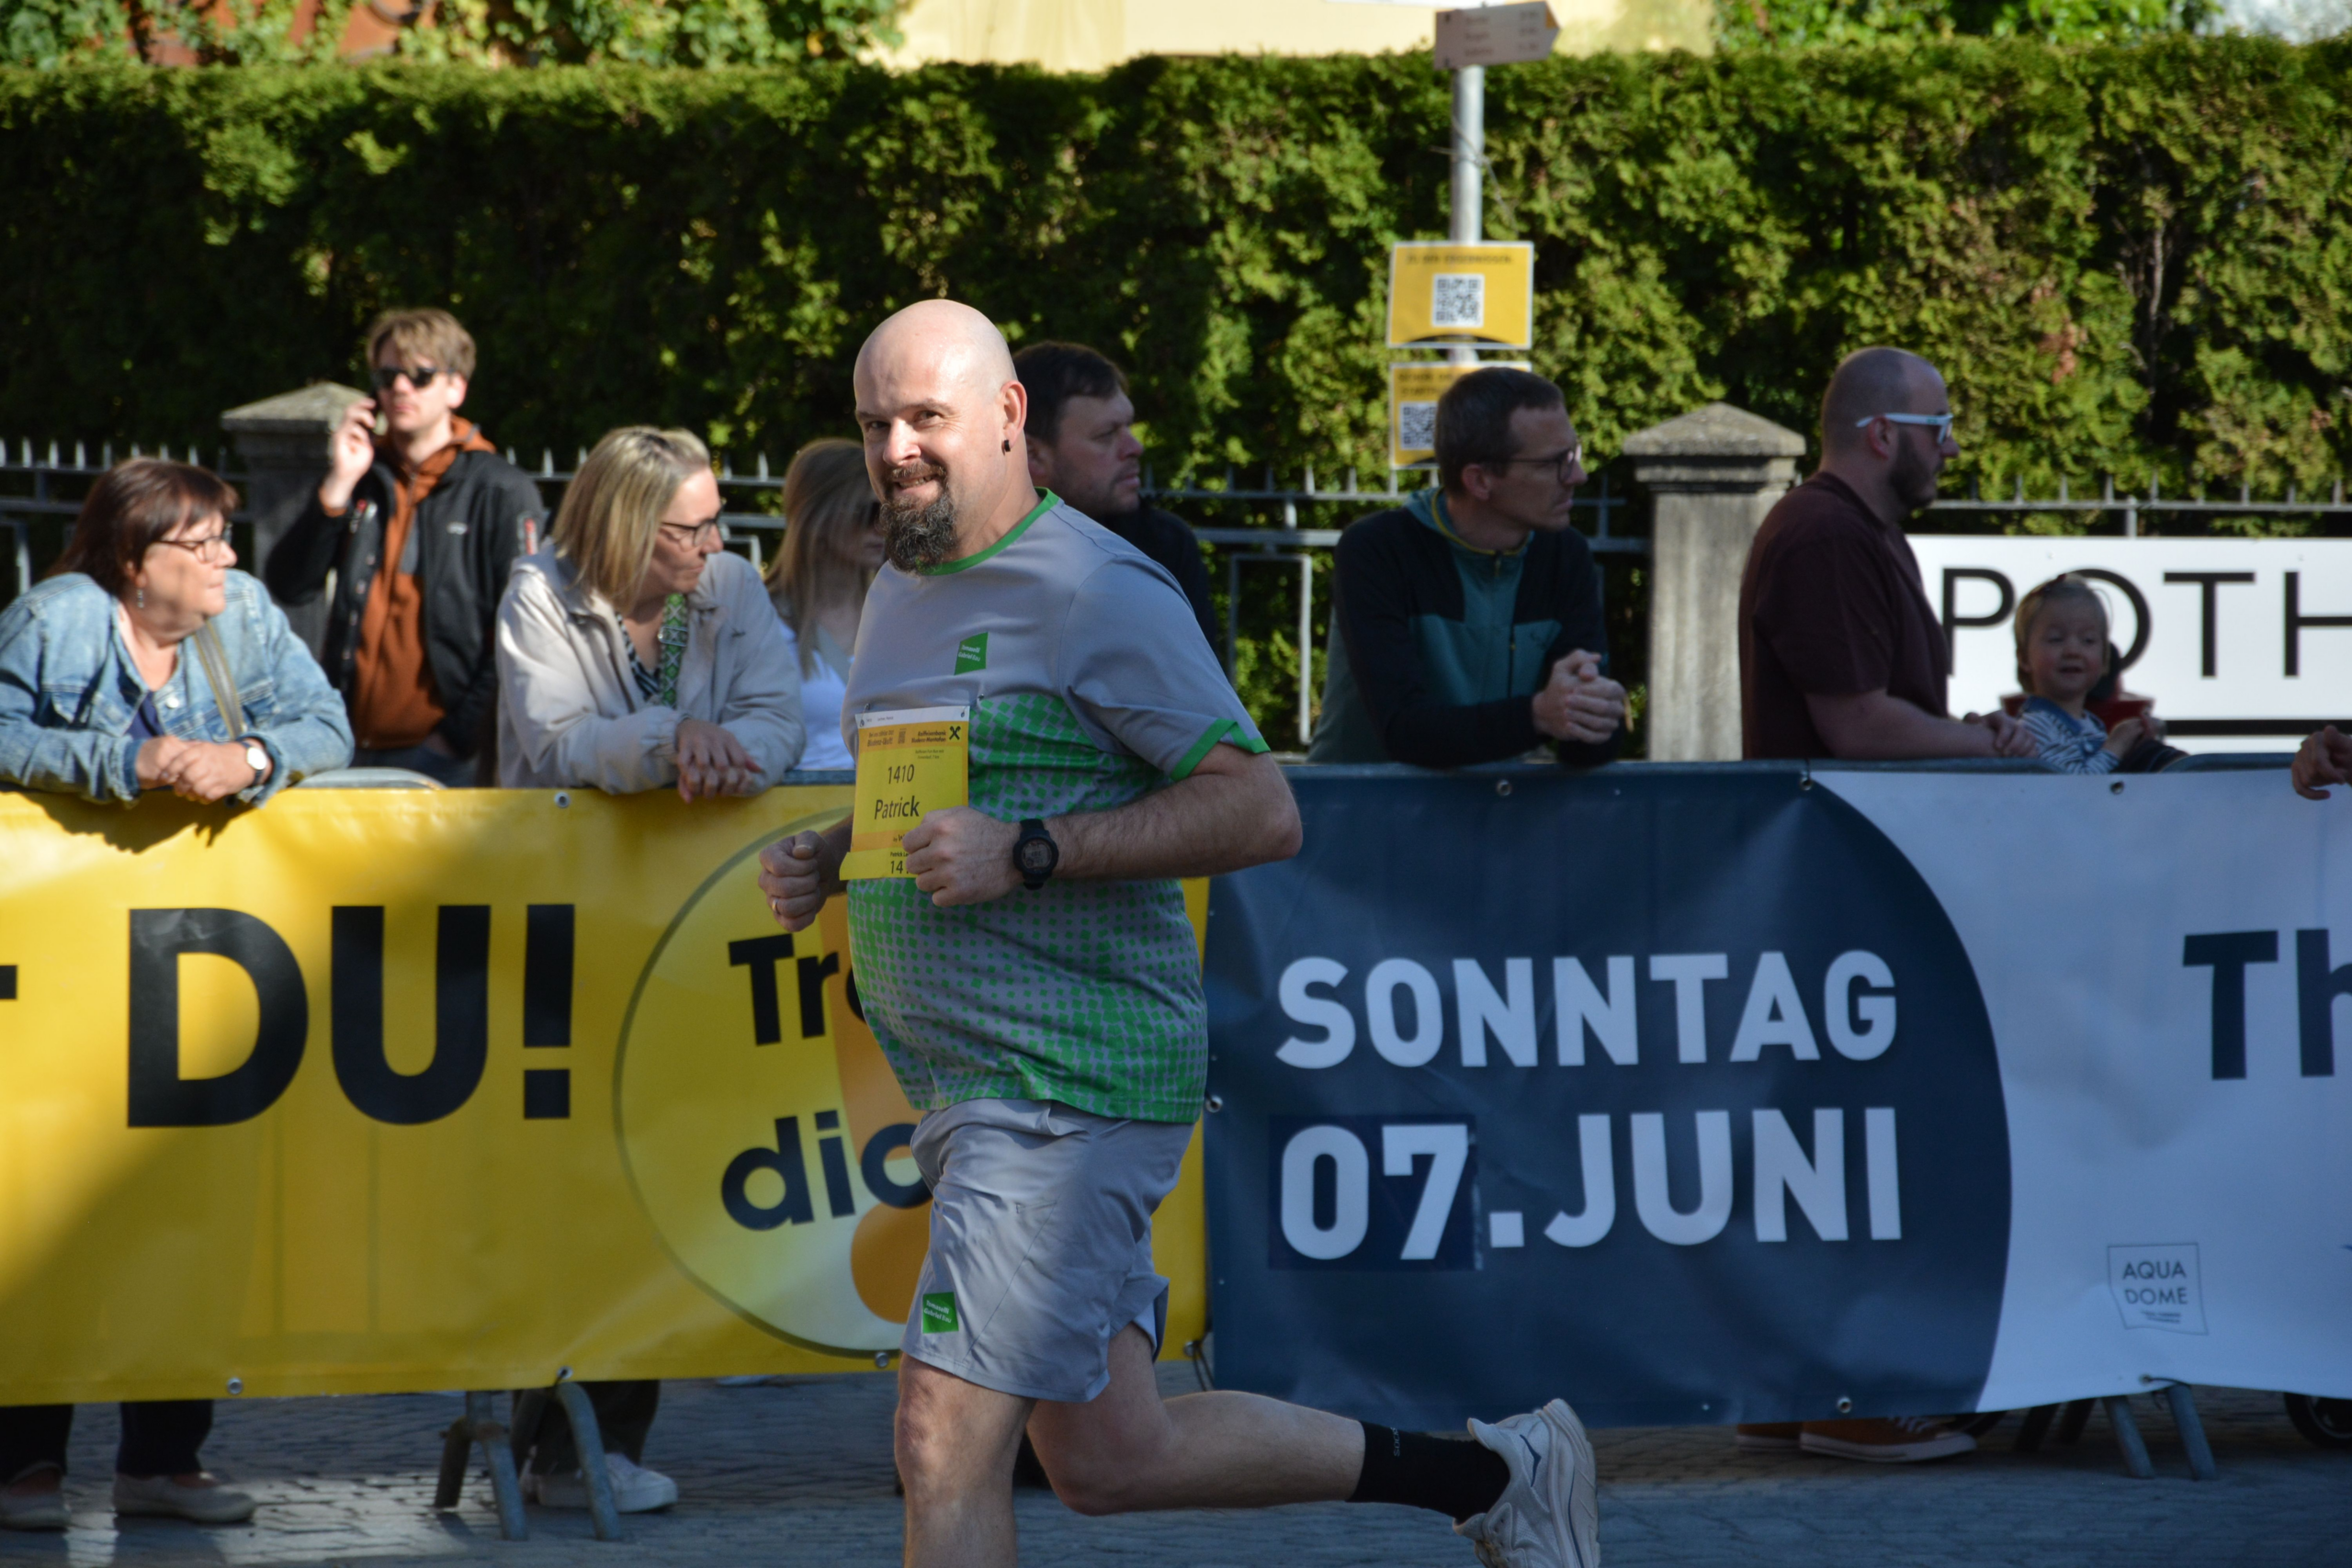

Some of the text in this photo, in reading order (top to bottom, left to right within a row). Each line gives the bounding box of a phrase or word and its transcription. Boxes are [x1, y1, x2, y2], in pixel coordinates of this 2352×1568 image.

[888, 764, 915, 784] 1410
[875, 795, 921, 819] Patrick
[890, 860, 909, 874] 14
[729, 933, 867, 1046] Tr
[127, 904, 575, 1128] DU!
[1274, 950, 1897, 1069] SONNTAG
[721, 1109, 936, 1232] dic
[2122, 1260, 2187, 1280] AQUA
[2124, 1287, 2188, 1304] DOME
